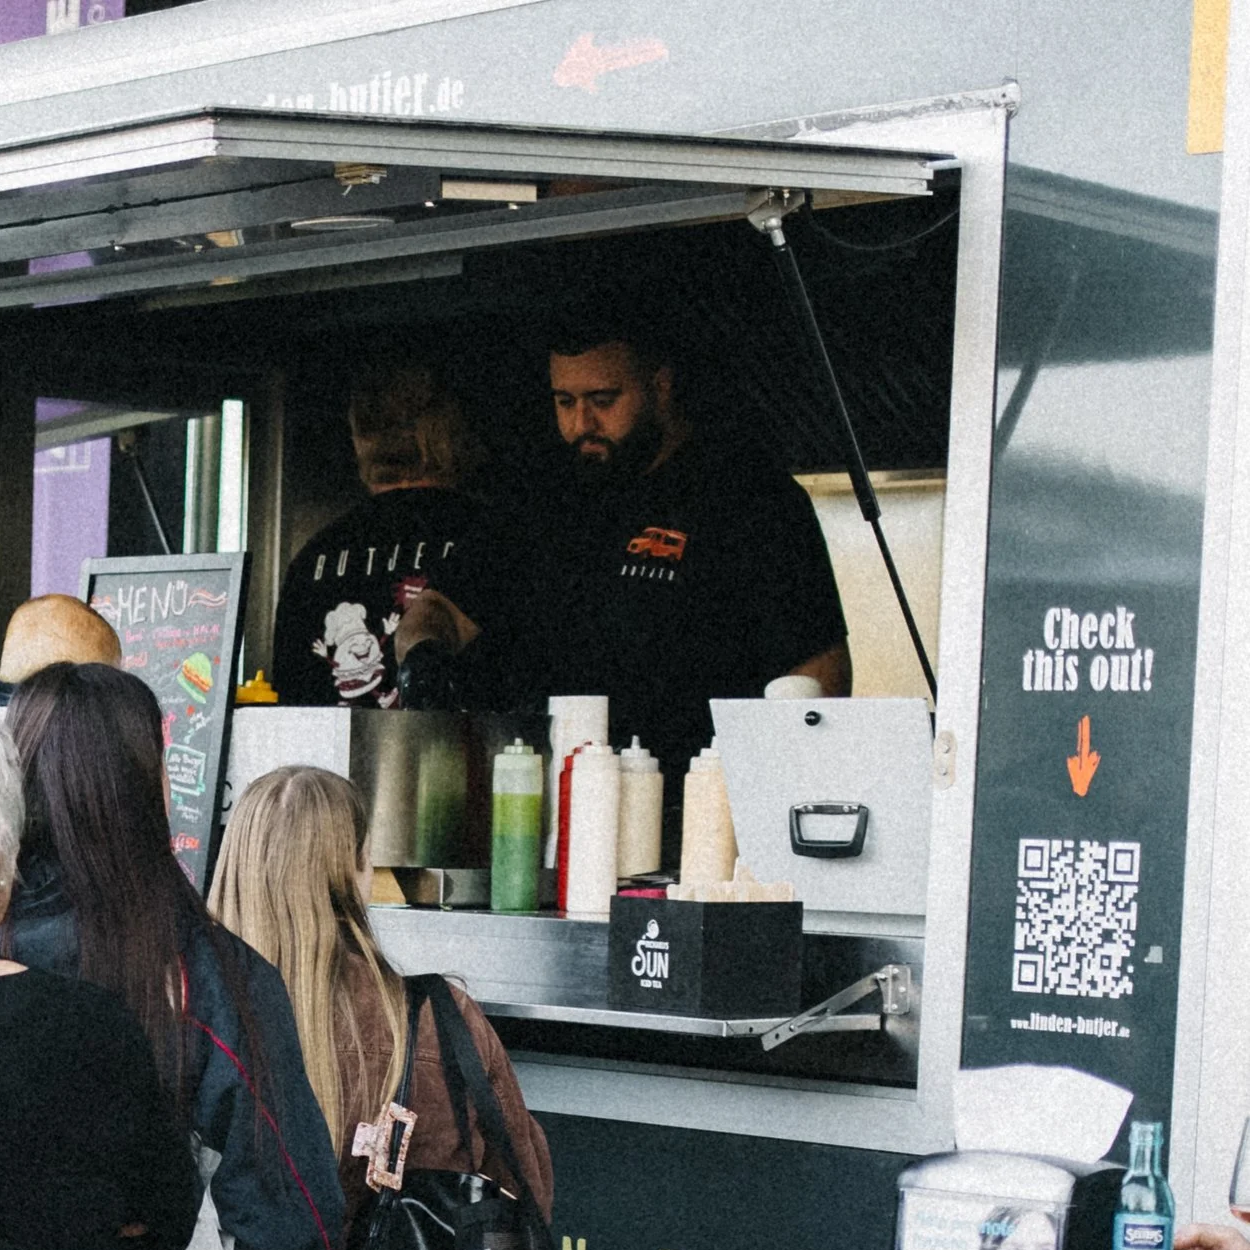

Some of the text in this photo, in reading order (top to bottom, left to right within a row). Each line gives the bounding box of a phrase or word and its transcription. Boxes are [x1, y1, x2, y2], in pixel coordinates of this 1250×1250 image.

[1044, 606, 1135, 649] Check
[1023, 648, 1154, 692] this out!
